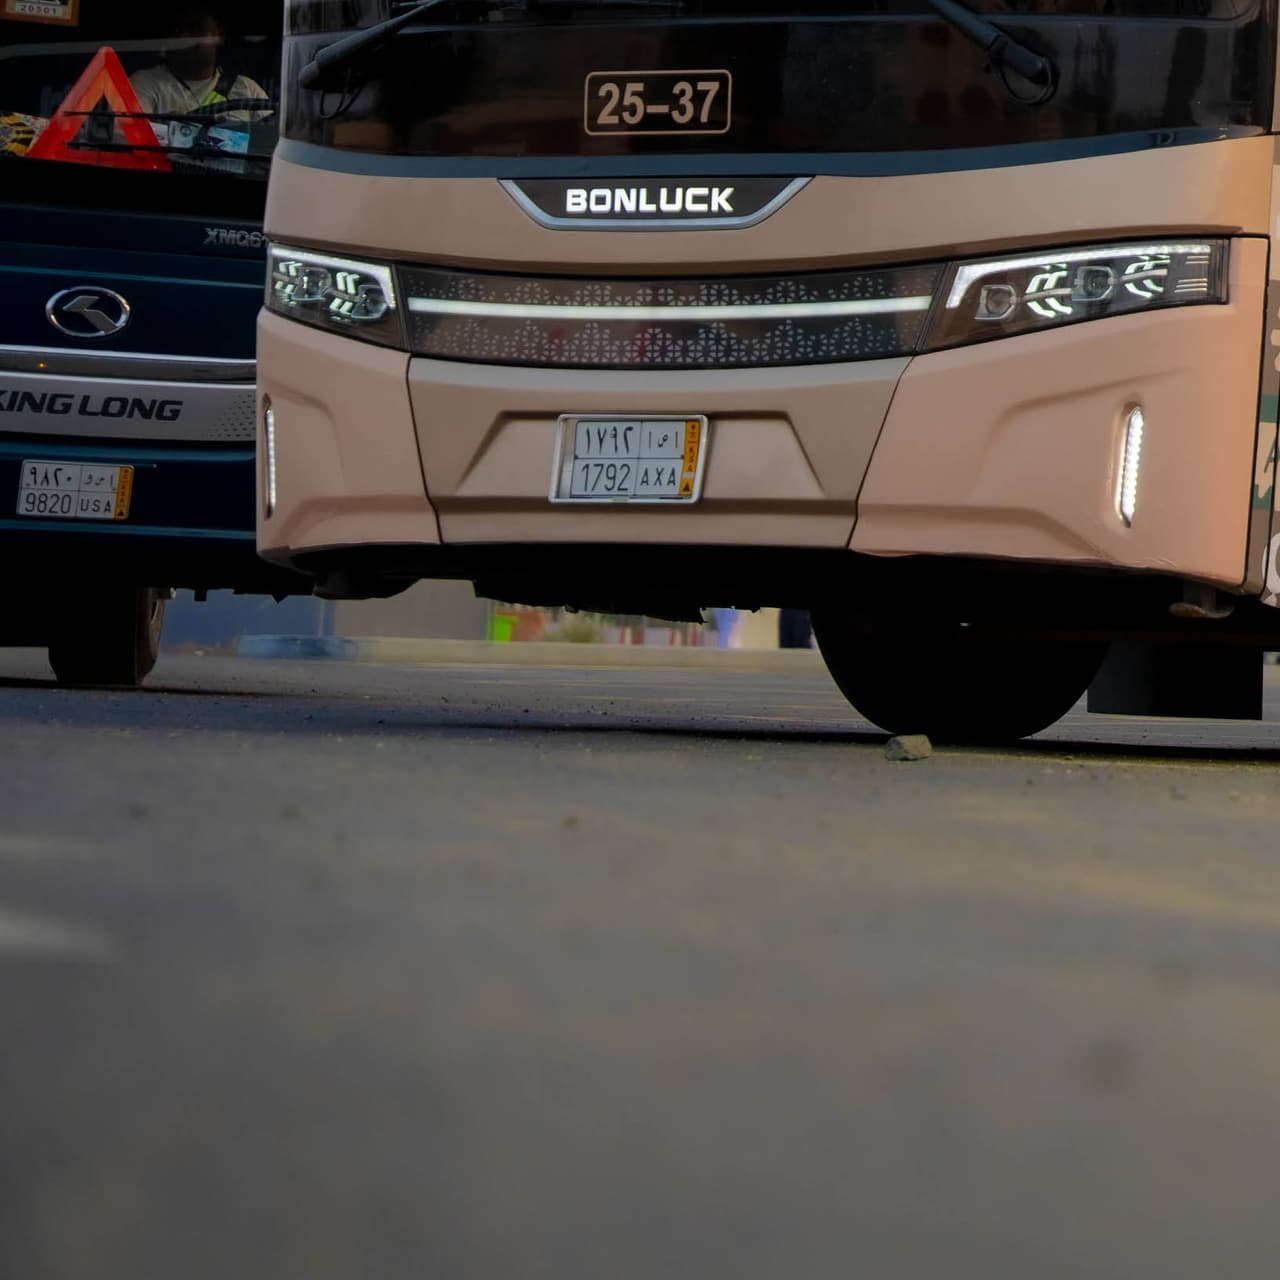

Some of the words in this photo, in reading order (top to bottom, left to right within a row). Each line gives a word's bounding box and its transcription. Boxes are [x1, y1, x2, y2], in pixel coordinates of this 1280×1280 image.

[596, 81, 721, 125] 25-37
[565, 187, 735, 213] BONLUCK
[203, 227, 269, 249] XMQ6
[78, 395, 183, 421] LONG
[581, 463, 631, 492] 1792
[24, 491, 73, 514] 9820
